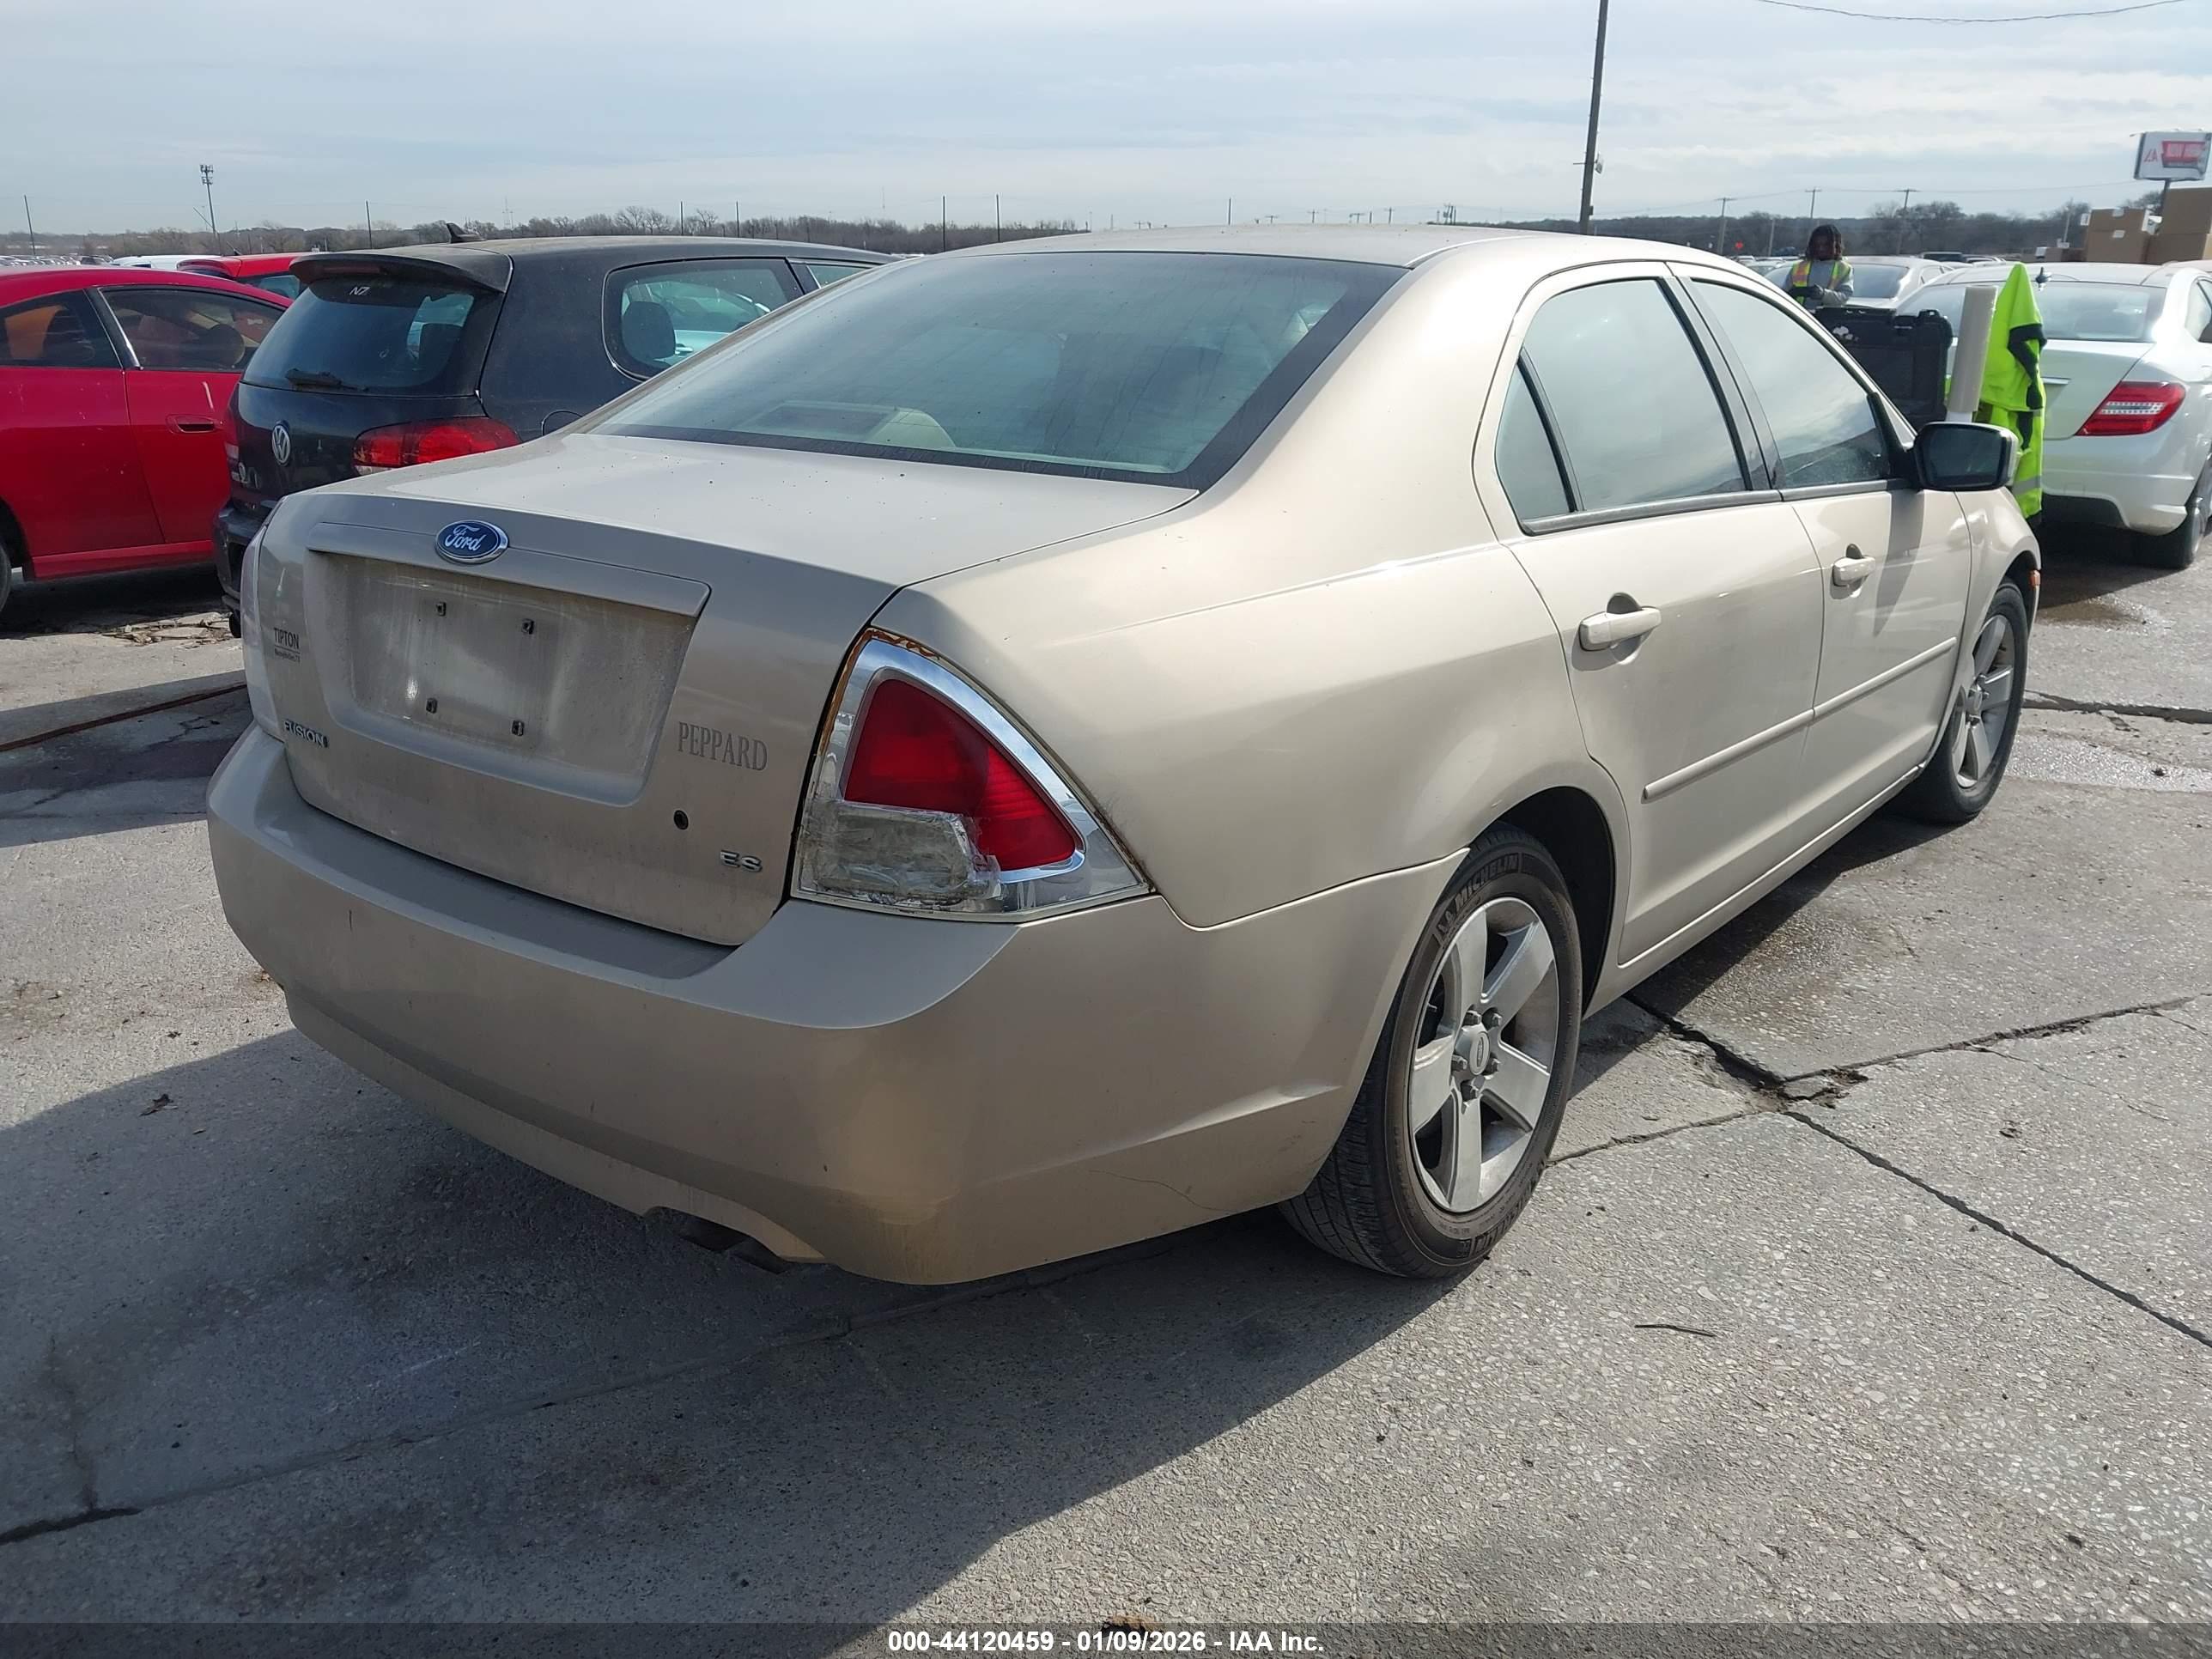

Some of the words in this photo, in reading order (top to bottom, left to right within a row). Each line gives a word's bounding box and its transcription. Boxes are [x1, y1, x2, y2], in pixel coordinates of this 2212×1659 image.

[444, 524, 487, 551] Ford
[274, 627, 300, 650] TIPTON
[283, 719, 327, 748] FUSION
[678, 721, 768, 771] PEPPARD
[720, 850, 763, 872] ES
[1454, 853, 1519, 915] MICHELIN
